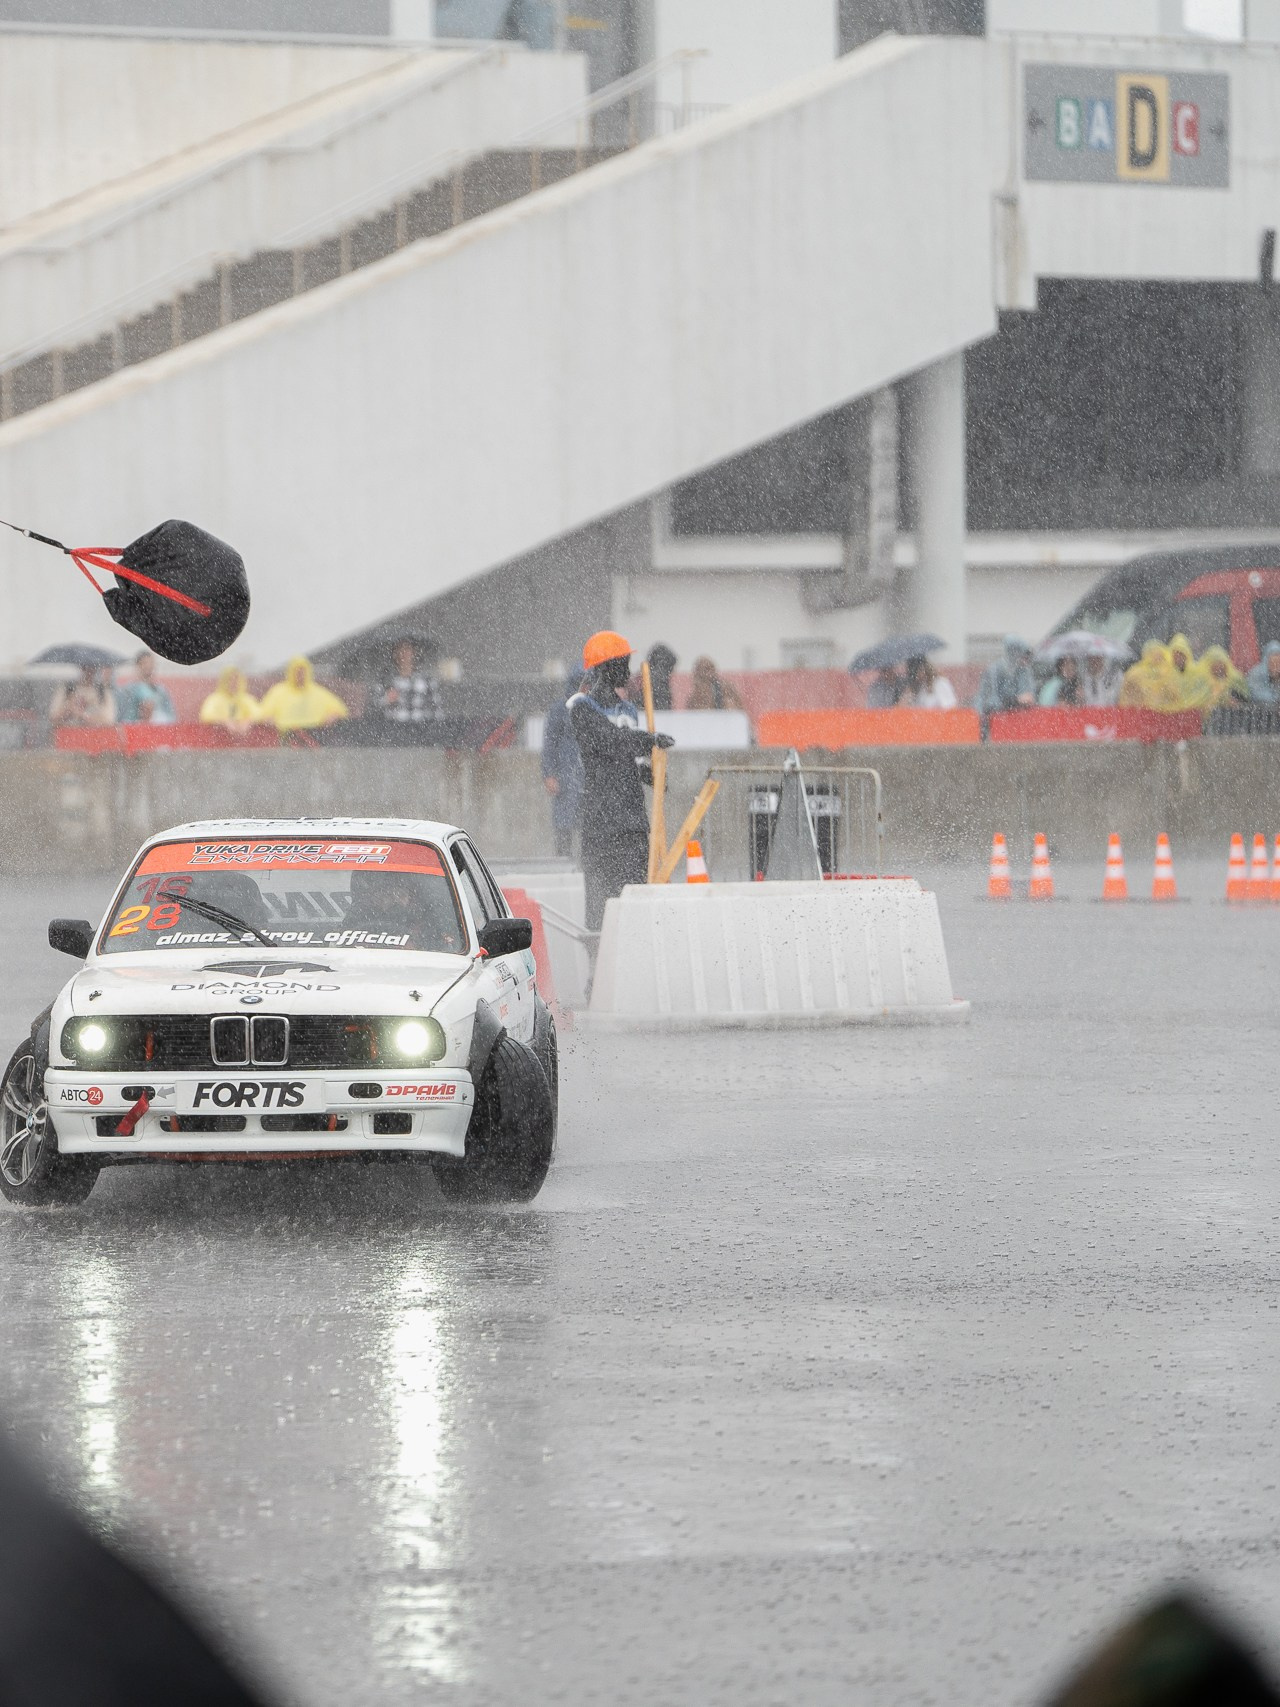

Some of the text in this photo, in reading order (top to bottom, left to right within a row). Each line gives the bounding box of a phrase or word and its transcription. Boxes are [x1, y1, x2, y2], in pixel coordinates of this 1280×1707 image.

[1086, 101, 1113, 148] A
[1127, 86, 1158, 167] D
[1176, 103, 1197, 150] C
[193, 844, 388, 855] YUKA DRIVE FEST
[136, 875, 193, 904] 16
[109, 903, 182, 937] 28
[171, 981, 341, 991] DIAMOND
[192, 1081, 307, 1108] FORTIS
[385, 1083, 457, 1096] ДРАЙВ
